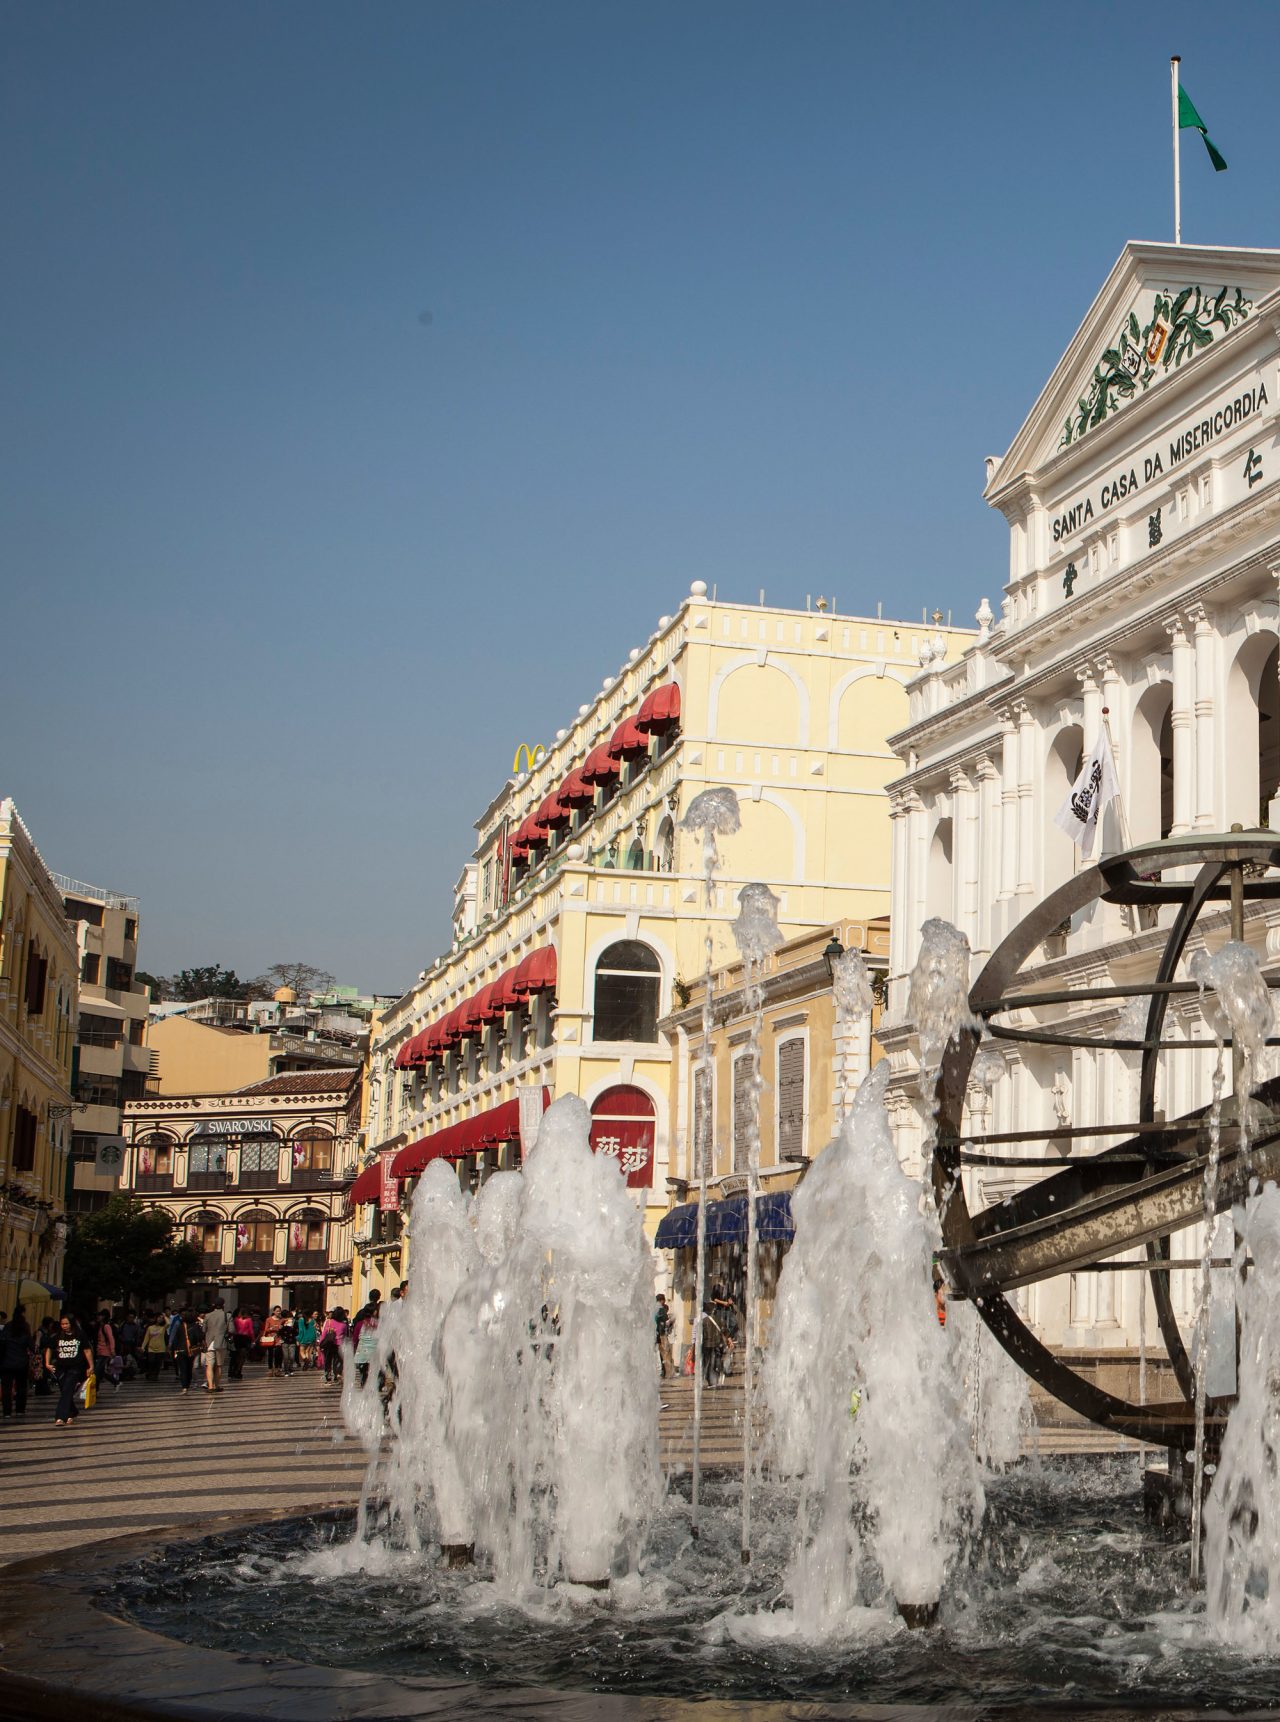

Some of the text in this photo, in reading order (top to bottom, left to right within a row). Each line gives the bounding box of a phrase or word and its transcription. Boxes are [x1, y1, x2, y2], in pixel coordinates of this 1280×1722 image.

[1053, 382, 1268, 542] SANTA CASA DA MISERICORDIA
[208, 1119, 271, 1134] SWAROVSKI
[595, 1136, 648, 1173] 莎莎
